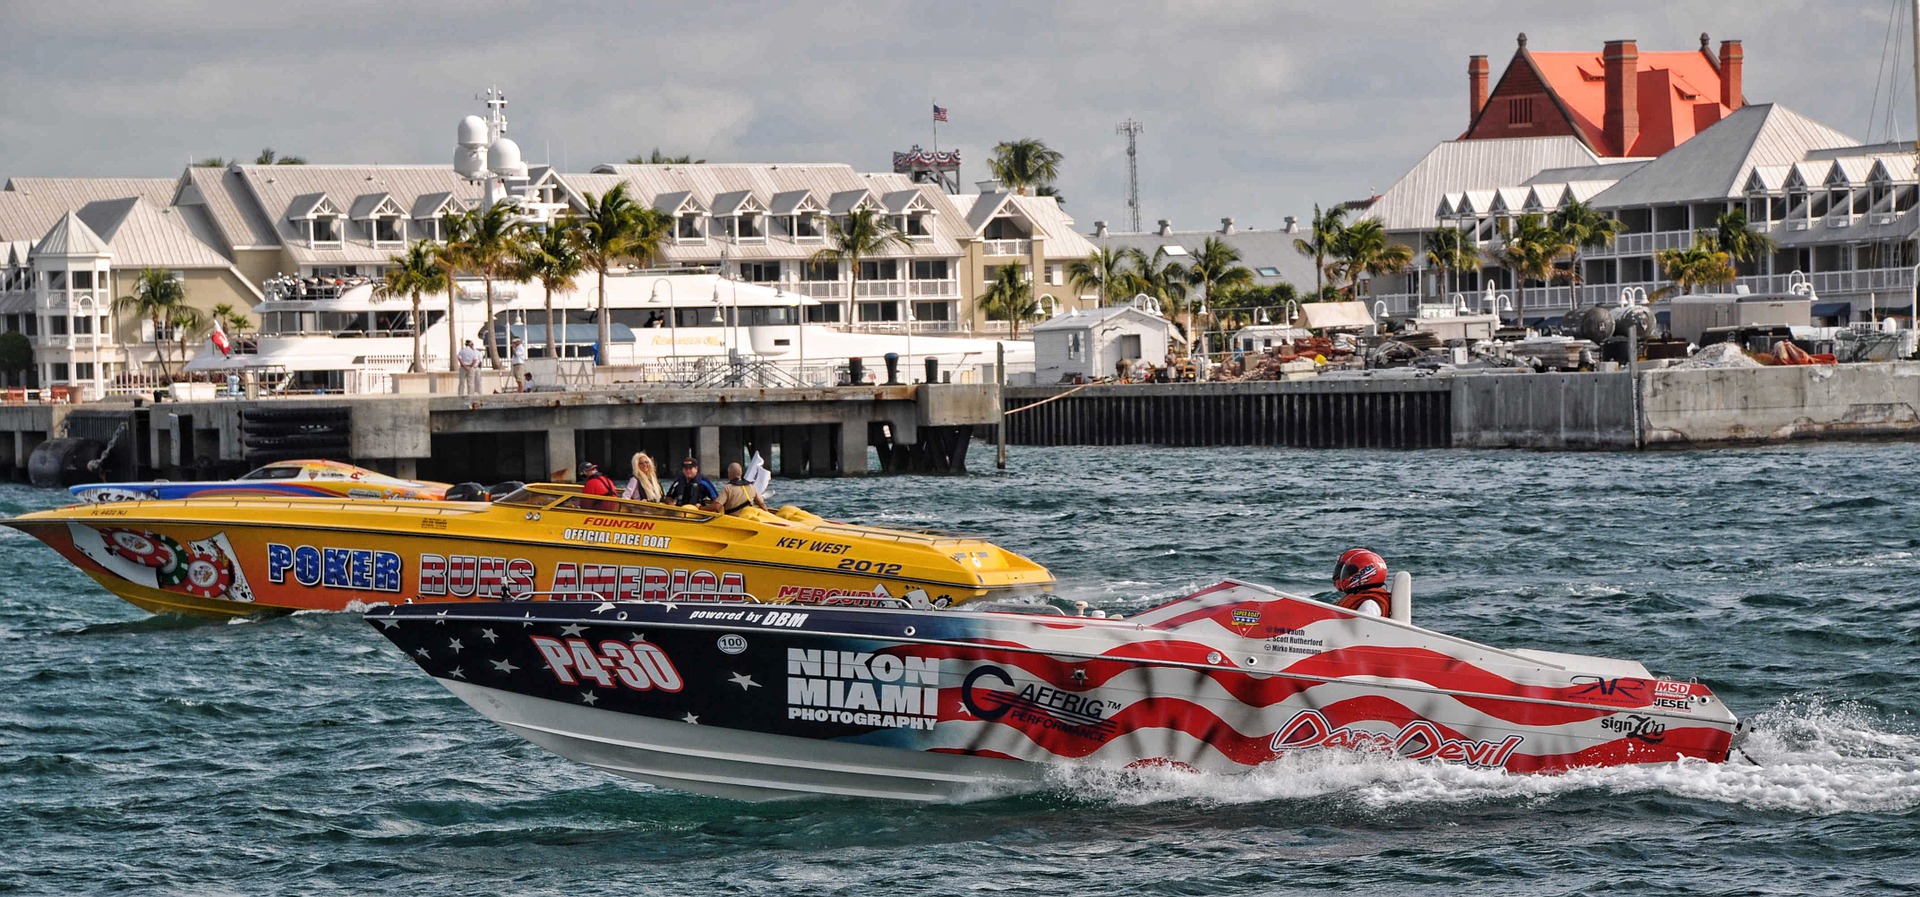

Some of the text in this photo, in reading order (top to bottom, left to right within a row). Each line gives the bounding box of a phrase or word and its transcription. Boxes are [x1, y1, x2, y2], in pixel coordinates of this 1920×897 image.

[583, 516, 655, 531] FOUNTAIN
[563, 528, 671, 549] OFFICIAL PACE BOAT
[776, 536, 851, 555] KEY WEST
[266, 543, 744, 601] POKER RUNS AMERICA
[837, 558, 902, 575] 2012
[777, 585, 886, 608] MERCURY
[689, 610, 809, 628] powered by DBM
[721, 638, 742, 647] 100
[1272, 635, 1323, 647] Scott Rutherford
[1272, 644, 1288, 652] Mirko
[530, 635, 684, 692] P4-30
[788, 648, 939, 685] NIKON
[788, 677, 938, 716] MIAMI
[1657, 682, 1688, 694] MSD
[1653, 698, 1691, 710] JESEL
[788, 707, 937, 731] PHOTOGRAPHY
[1010, 710, 1108, 742] PERFORMANCE
